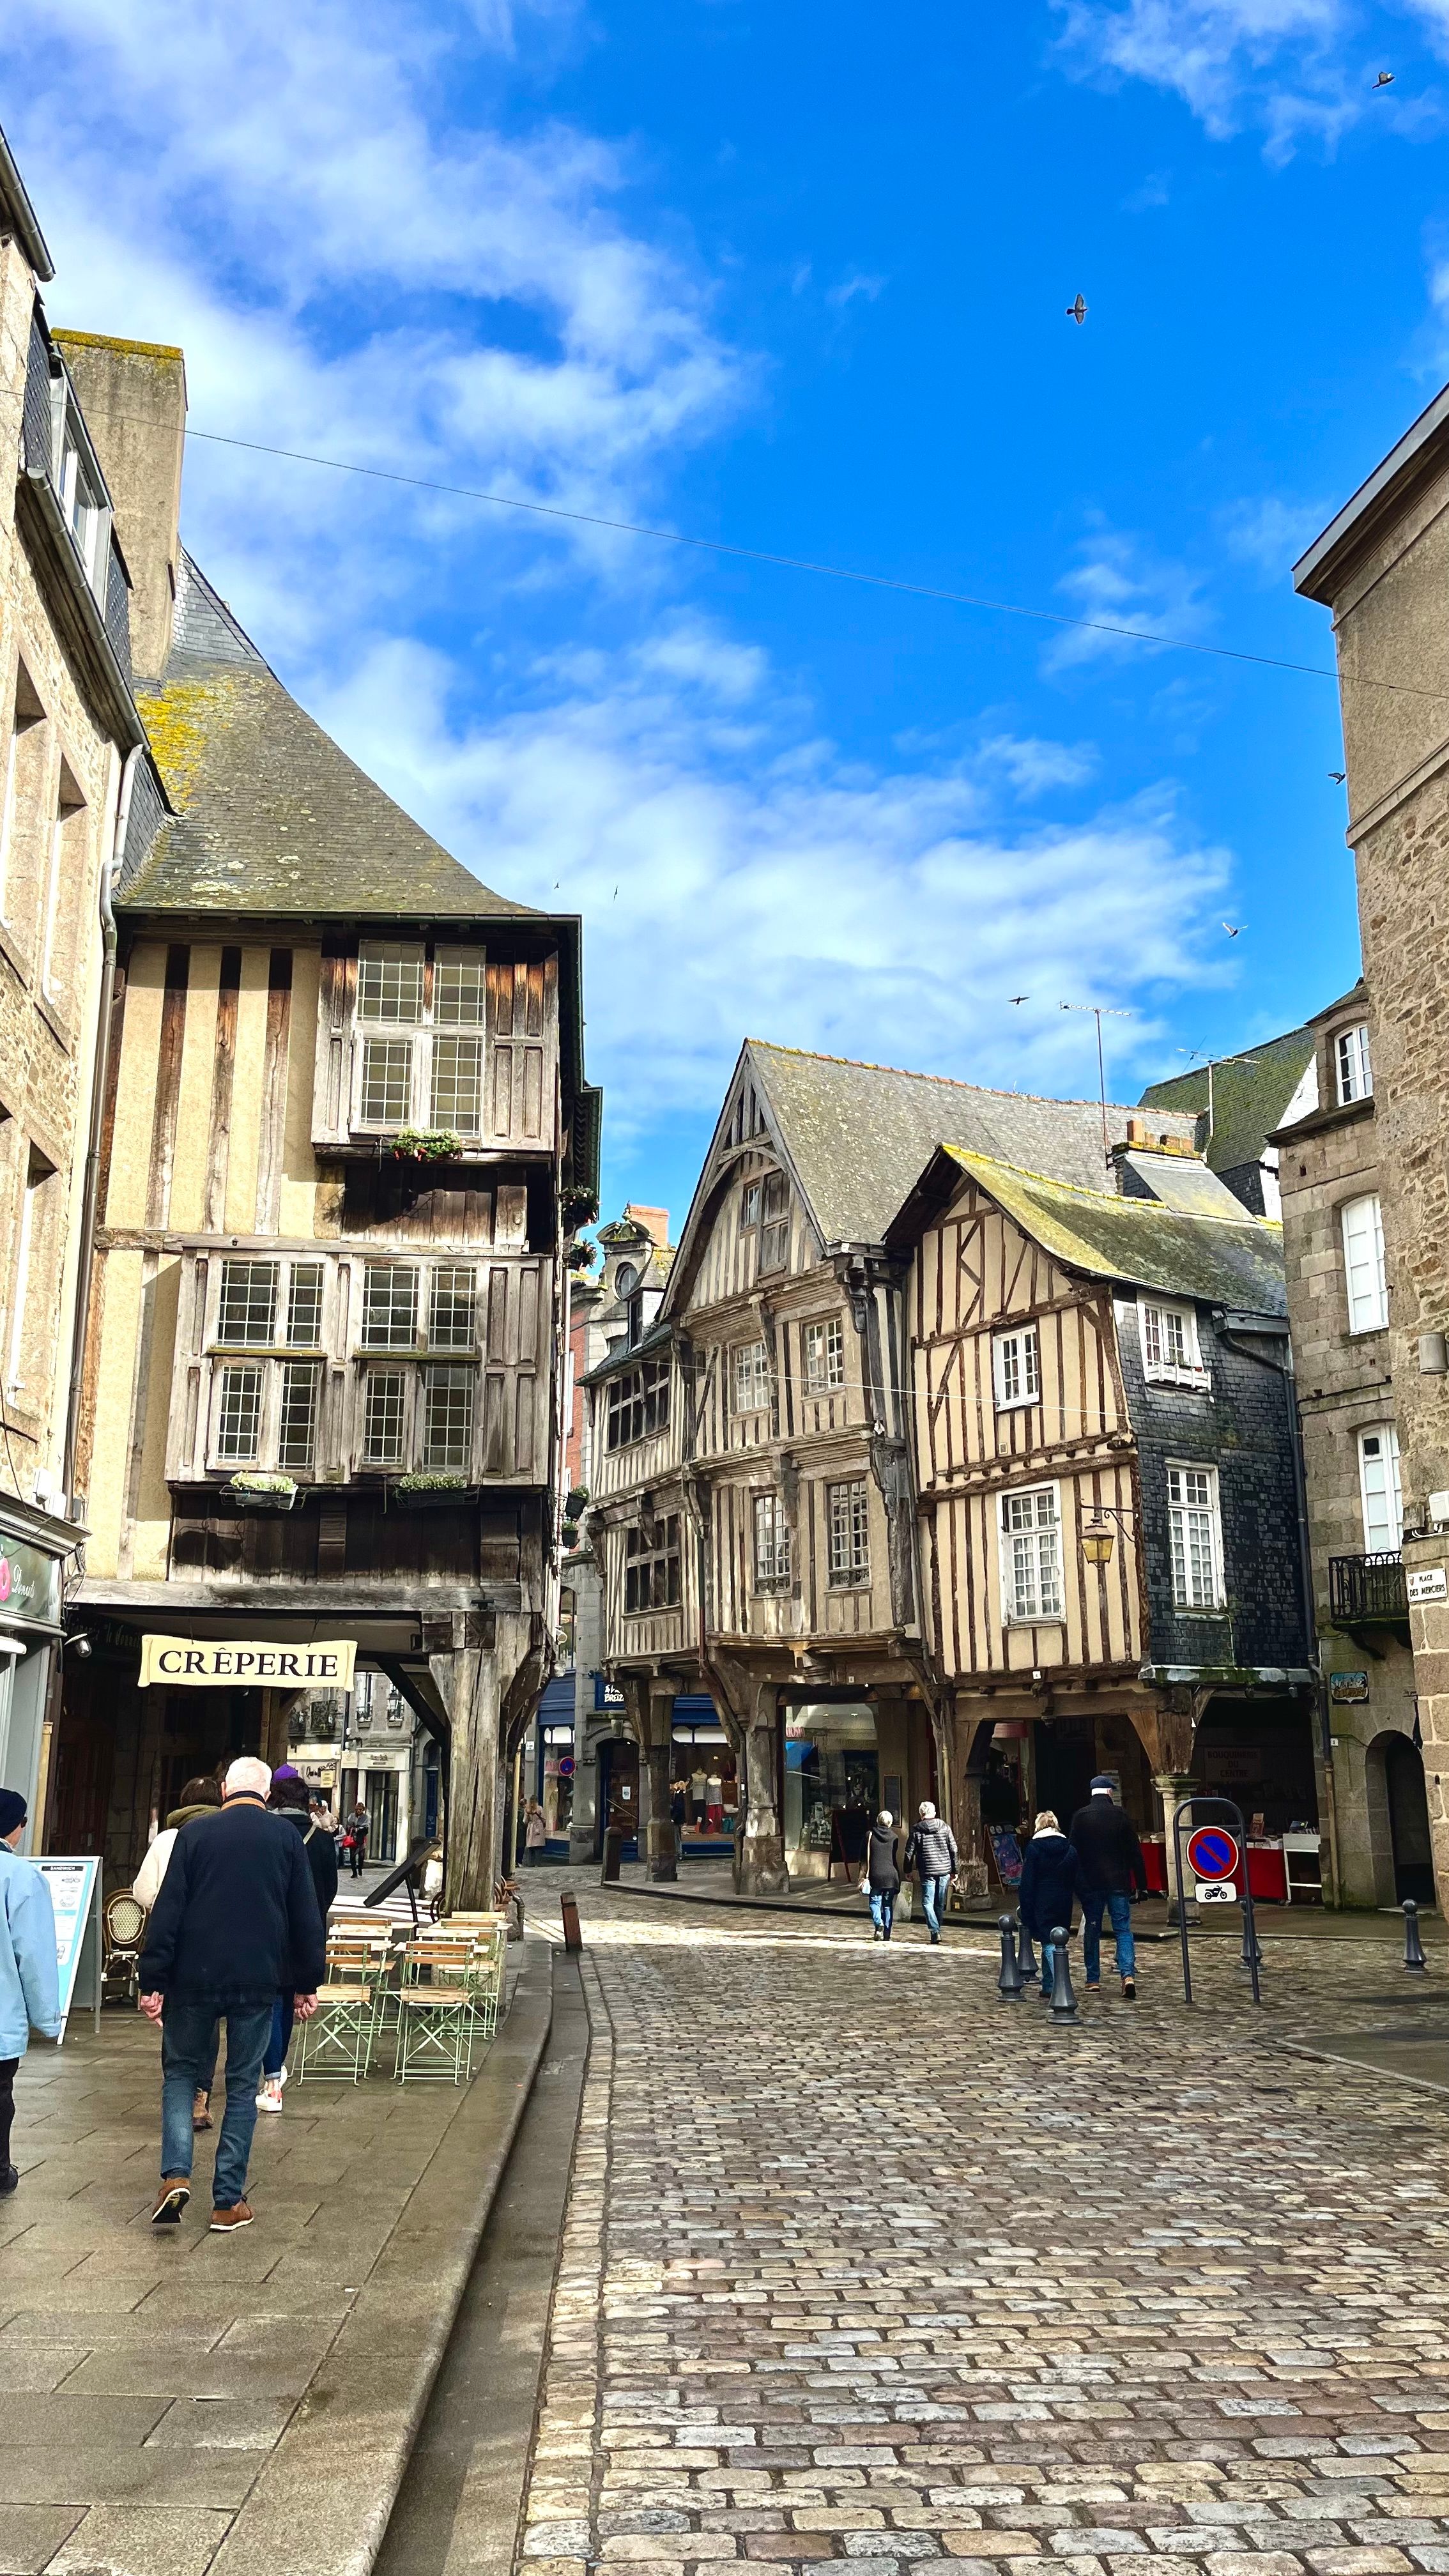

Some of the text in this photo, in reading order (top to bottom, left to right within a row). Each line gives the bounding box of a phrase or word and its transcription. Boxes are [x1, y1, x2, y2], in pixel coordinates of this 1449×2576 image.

[12, 1565, 35, 1598] Donuts
[1419, 1574, 1432, 1583] PLACE
[1409, 1584, 1445, 1597] DES MERCIERS
[159, 1647, 338, 1677] CRÊPERIE
[604, 1693, 624, 1702] BREIZ
[1208, 1751, 1258, 1759] BOUQUINERIE
